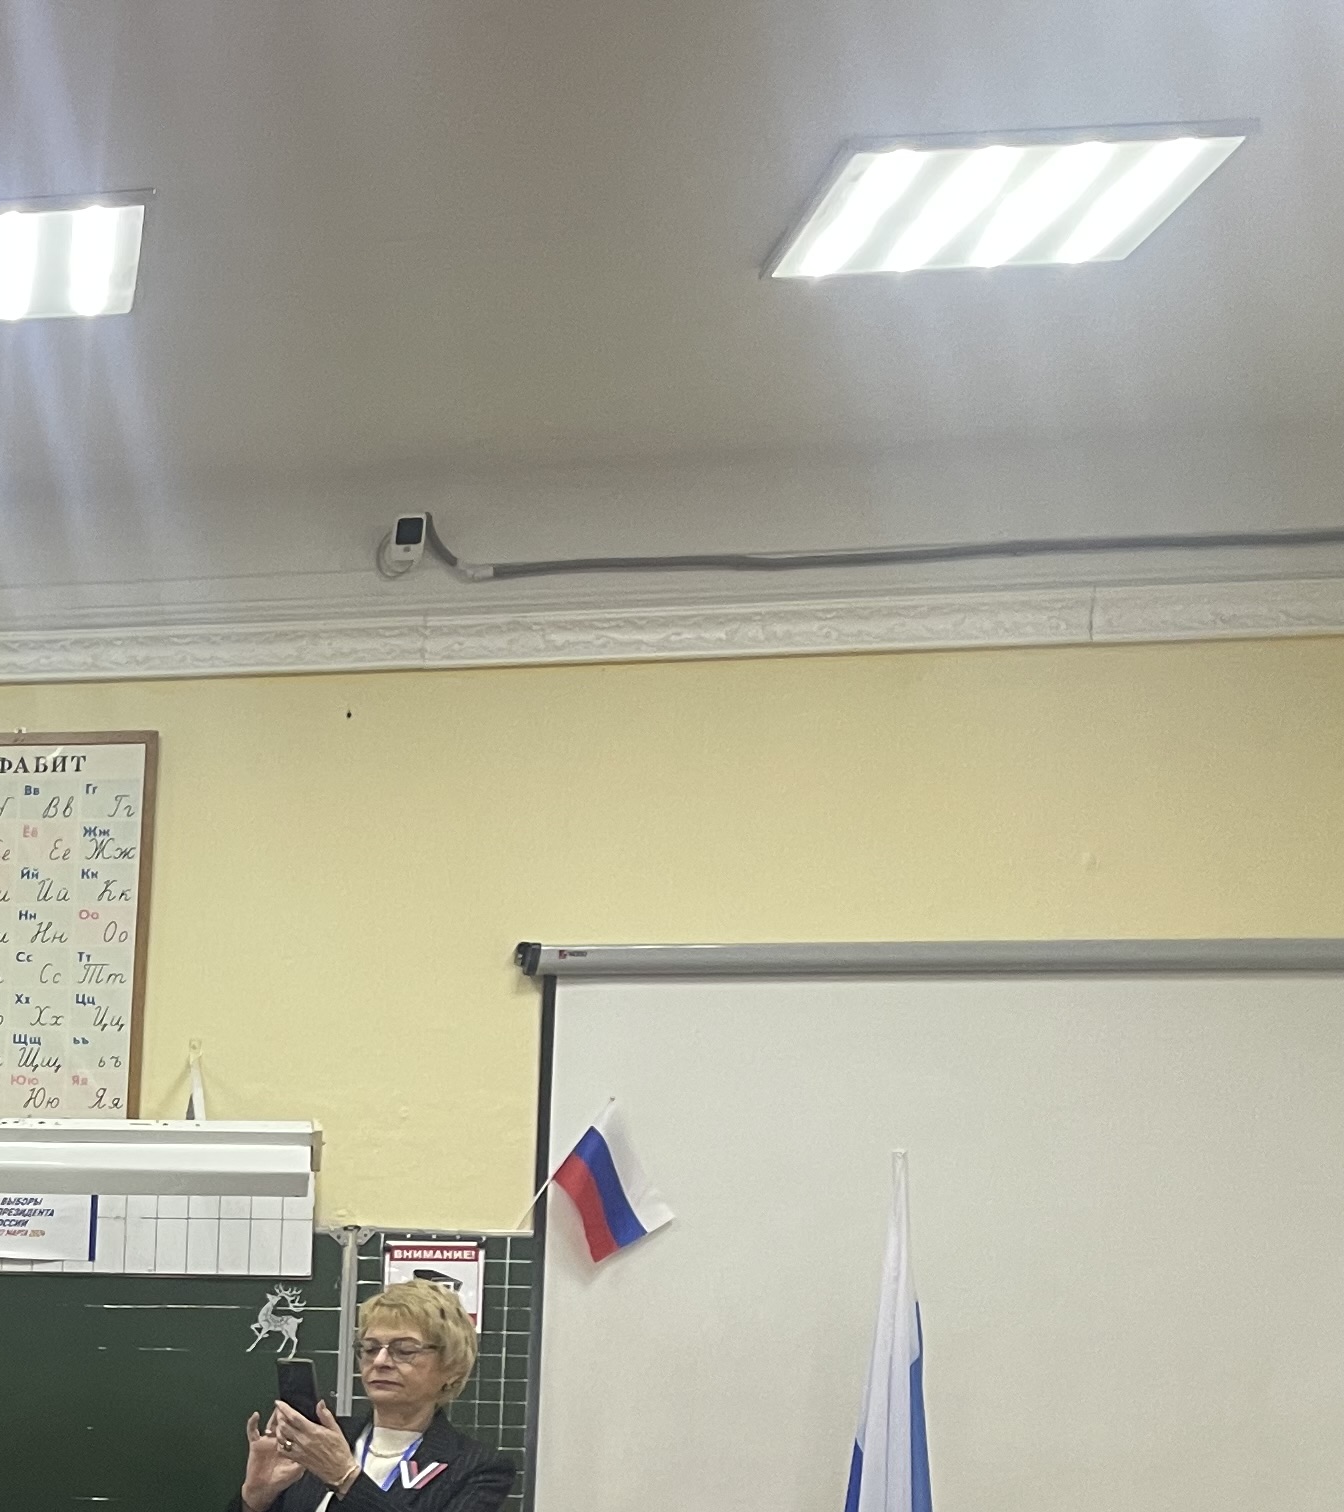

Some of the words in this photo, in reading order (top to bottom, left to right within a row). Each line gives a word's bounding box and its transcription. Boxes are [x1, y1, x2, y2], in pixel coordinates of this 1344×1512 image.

[25, 786, 39, 795] Вв
[86, 784, 97, 794] Гг
[42, 796, 74, 818] Вв
[108, 794, 135, 817] Гг
[83, 826, 110, 837] Жж
[85, 838, 136, 859] Жж
[97, 880, 131, 901] Кк
[19, 911, 37, 920] Нн
[79, 910, 99, 920] Оо
[30, 922, 68, 943] Нн
[104, 921, 128, 942] Оо
[16, 952, 33, 962] Сс
[78, 952, 91, 962] Тт
[40, 963, 61, 984] Сс
[77, 964, 126, 984] Тт
[15, 994, 30, 1004] Хх
[76, 994, 95, 1006] Цц
[30, 1006, 64, 1026] Хх
[93, 1006, 125, 1031] Цц
[13, 1034, 41, 1045] Щщ
[18, 1047, 62, 1073] Щщ
[11, 1075, 39, 1085] Юю
[23, 1087, 60, 1109] Юю
[88, 1087, 123, 1110] Яя
[0, 1197, 43, 1206] ВЫБОРЫ
[393, 1249, 476, 1260] ВНИМАНИЕ!
